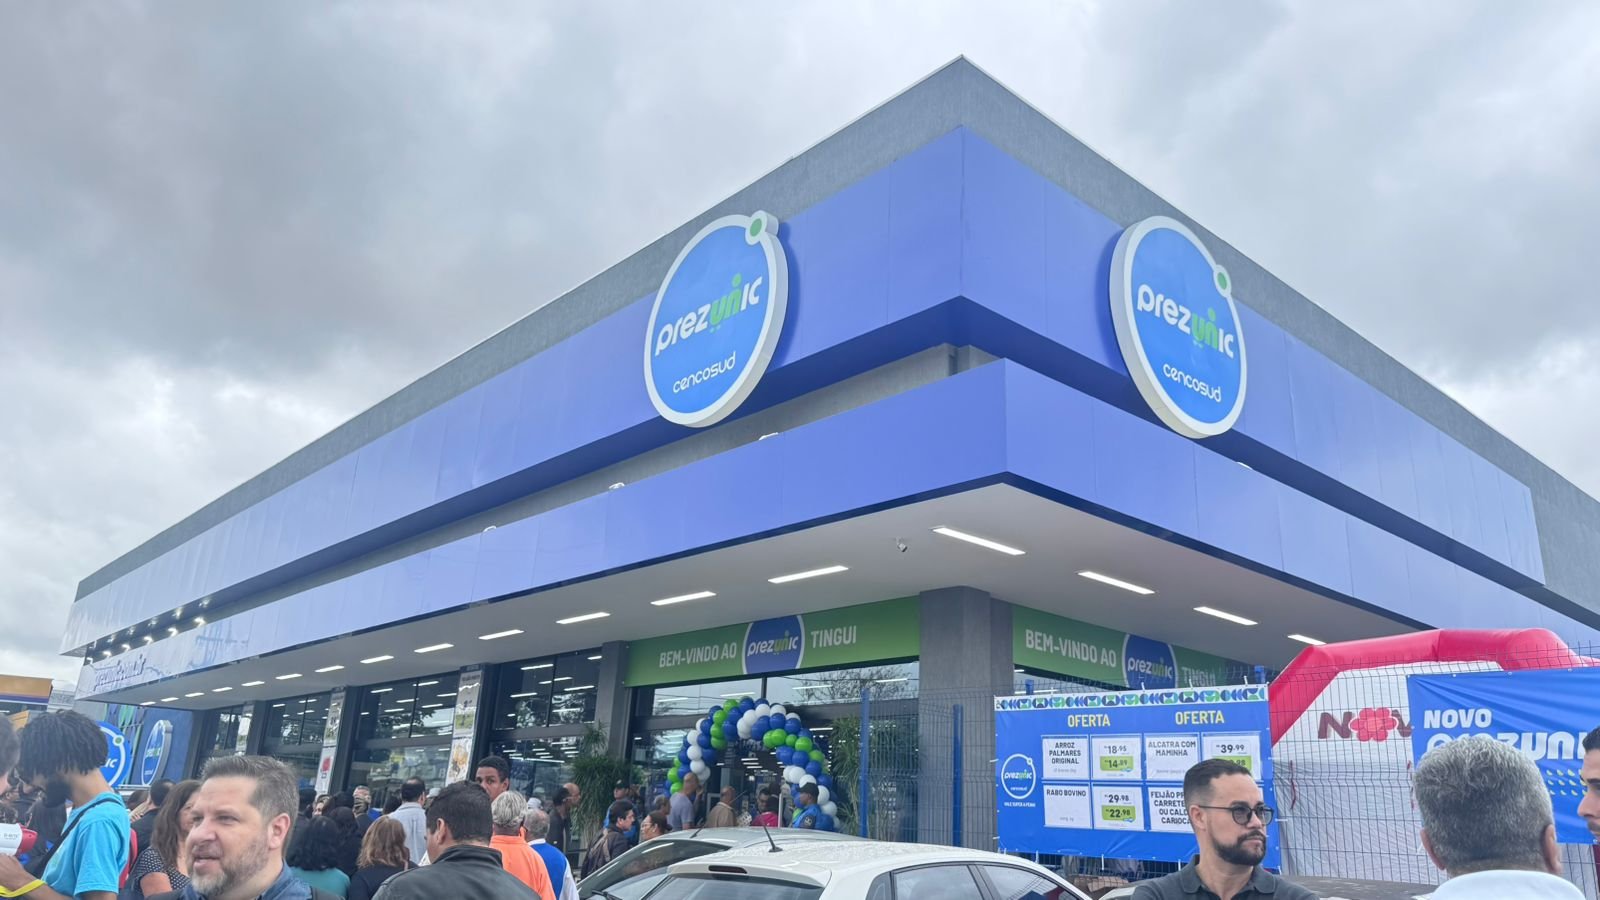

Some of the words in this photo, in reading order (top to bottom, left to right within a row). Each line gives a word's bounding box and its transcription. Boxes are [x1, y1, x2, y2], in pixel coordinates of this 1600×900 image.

[655, 273, 763, 357] prezunic
[1137, 284, 1234, 358] prezunic
[672, 351, 736, 393] cencosud
[1162, 363, 1222, 402] cencosud
[811, 625, 857, 648] TINGUI
[659, 645, 719, 668] BEM-VINDO
[720, 642, 737, 660] AO
[1025, 629, 1098, 663] BEM-VINDO
[1100, 648, 1117, 668] AO
[1067, 714, 1111, 728] OFERTA
[1175, 710, 1225, 725] OFERTA
[1423, 708, 1492, 729] NOVO
[1051, 757, 1079, 765] ORIGINAL
[1064, 789, 1087, 797] BOVINO
[1151, 790, 1175, 798] FEIJÃO
